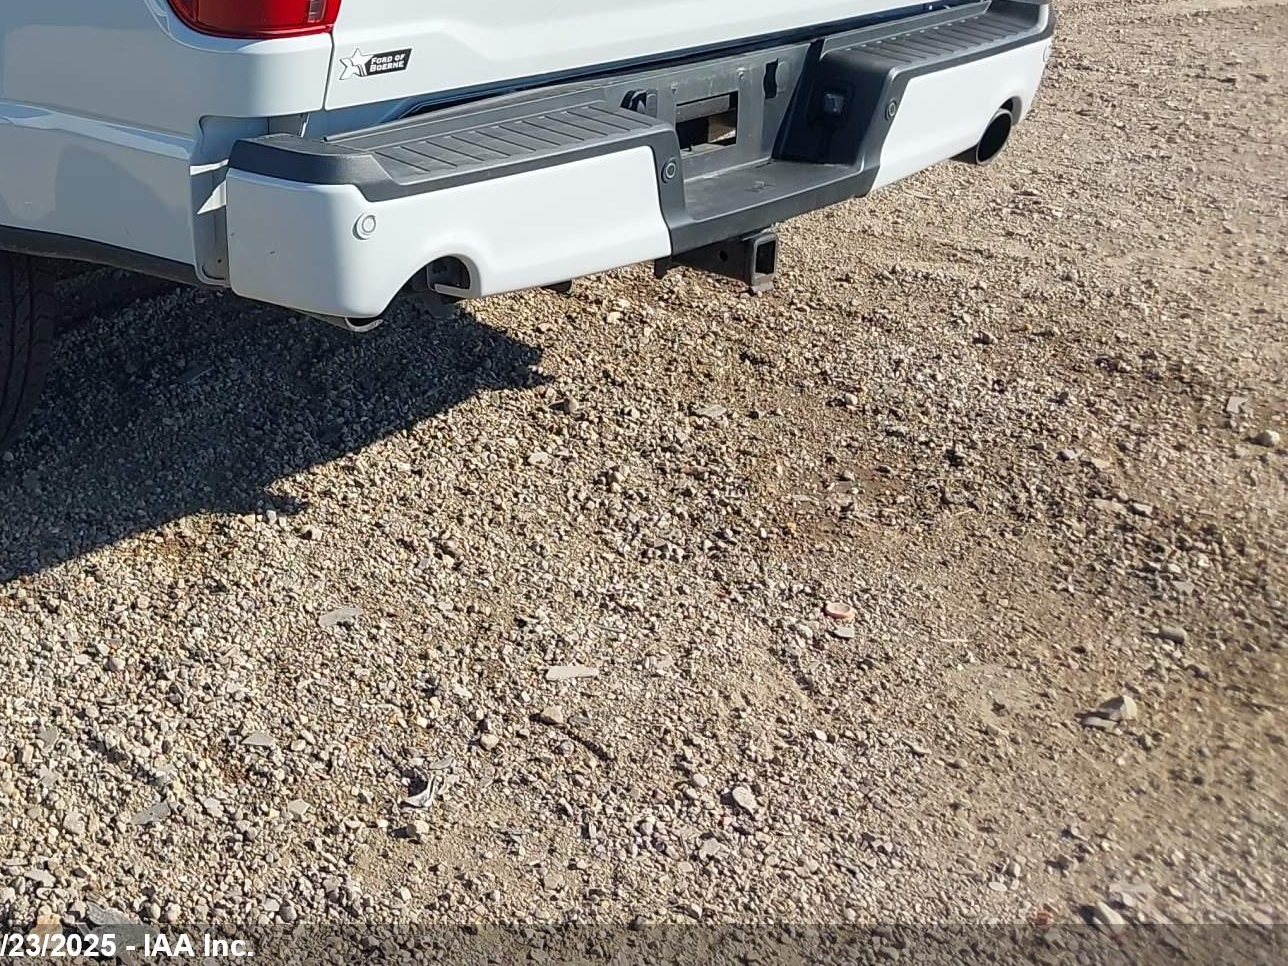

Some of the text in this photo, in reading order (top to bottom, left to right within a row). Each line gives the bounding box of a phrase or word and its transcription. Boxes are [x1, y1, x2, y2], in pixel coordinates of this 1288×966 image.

[370, 53, 406, 65] FORD OF
[369, 60, 405, 73] BOERNE
